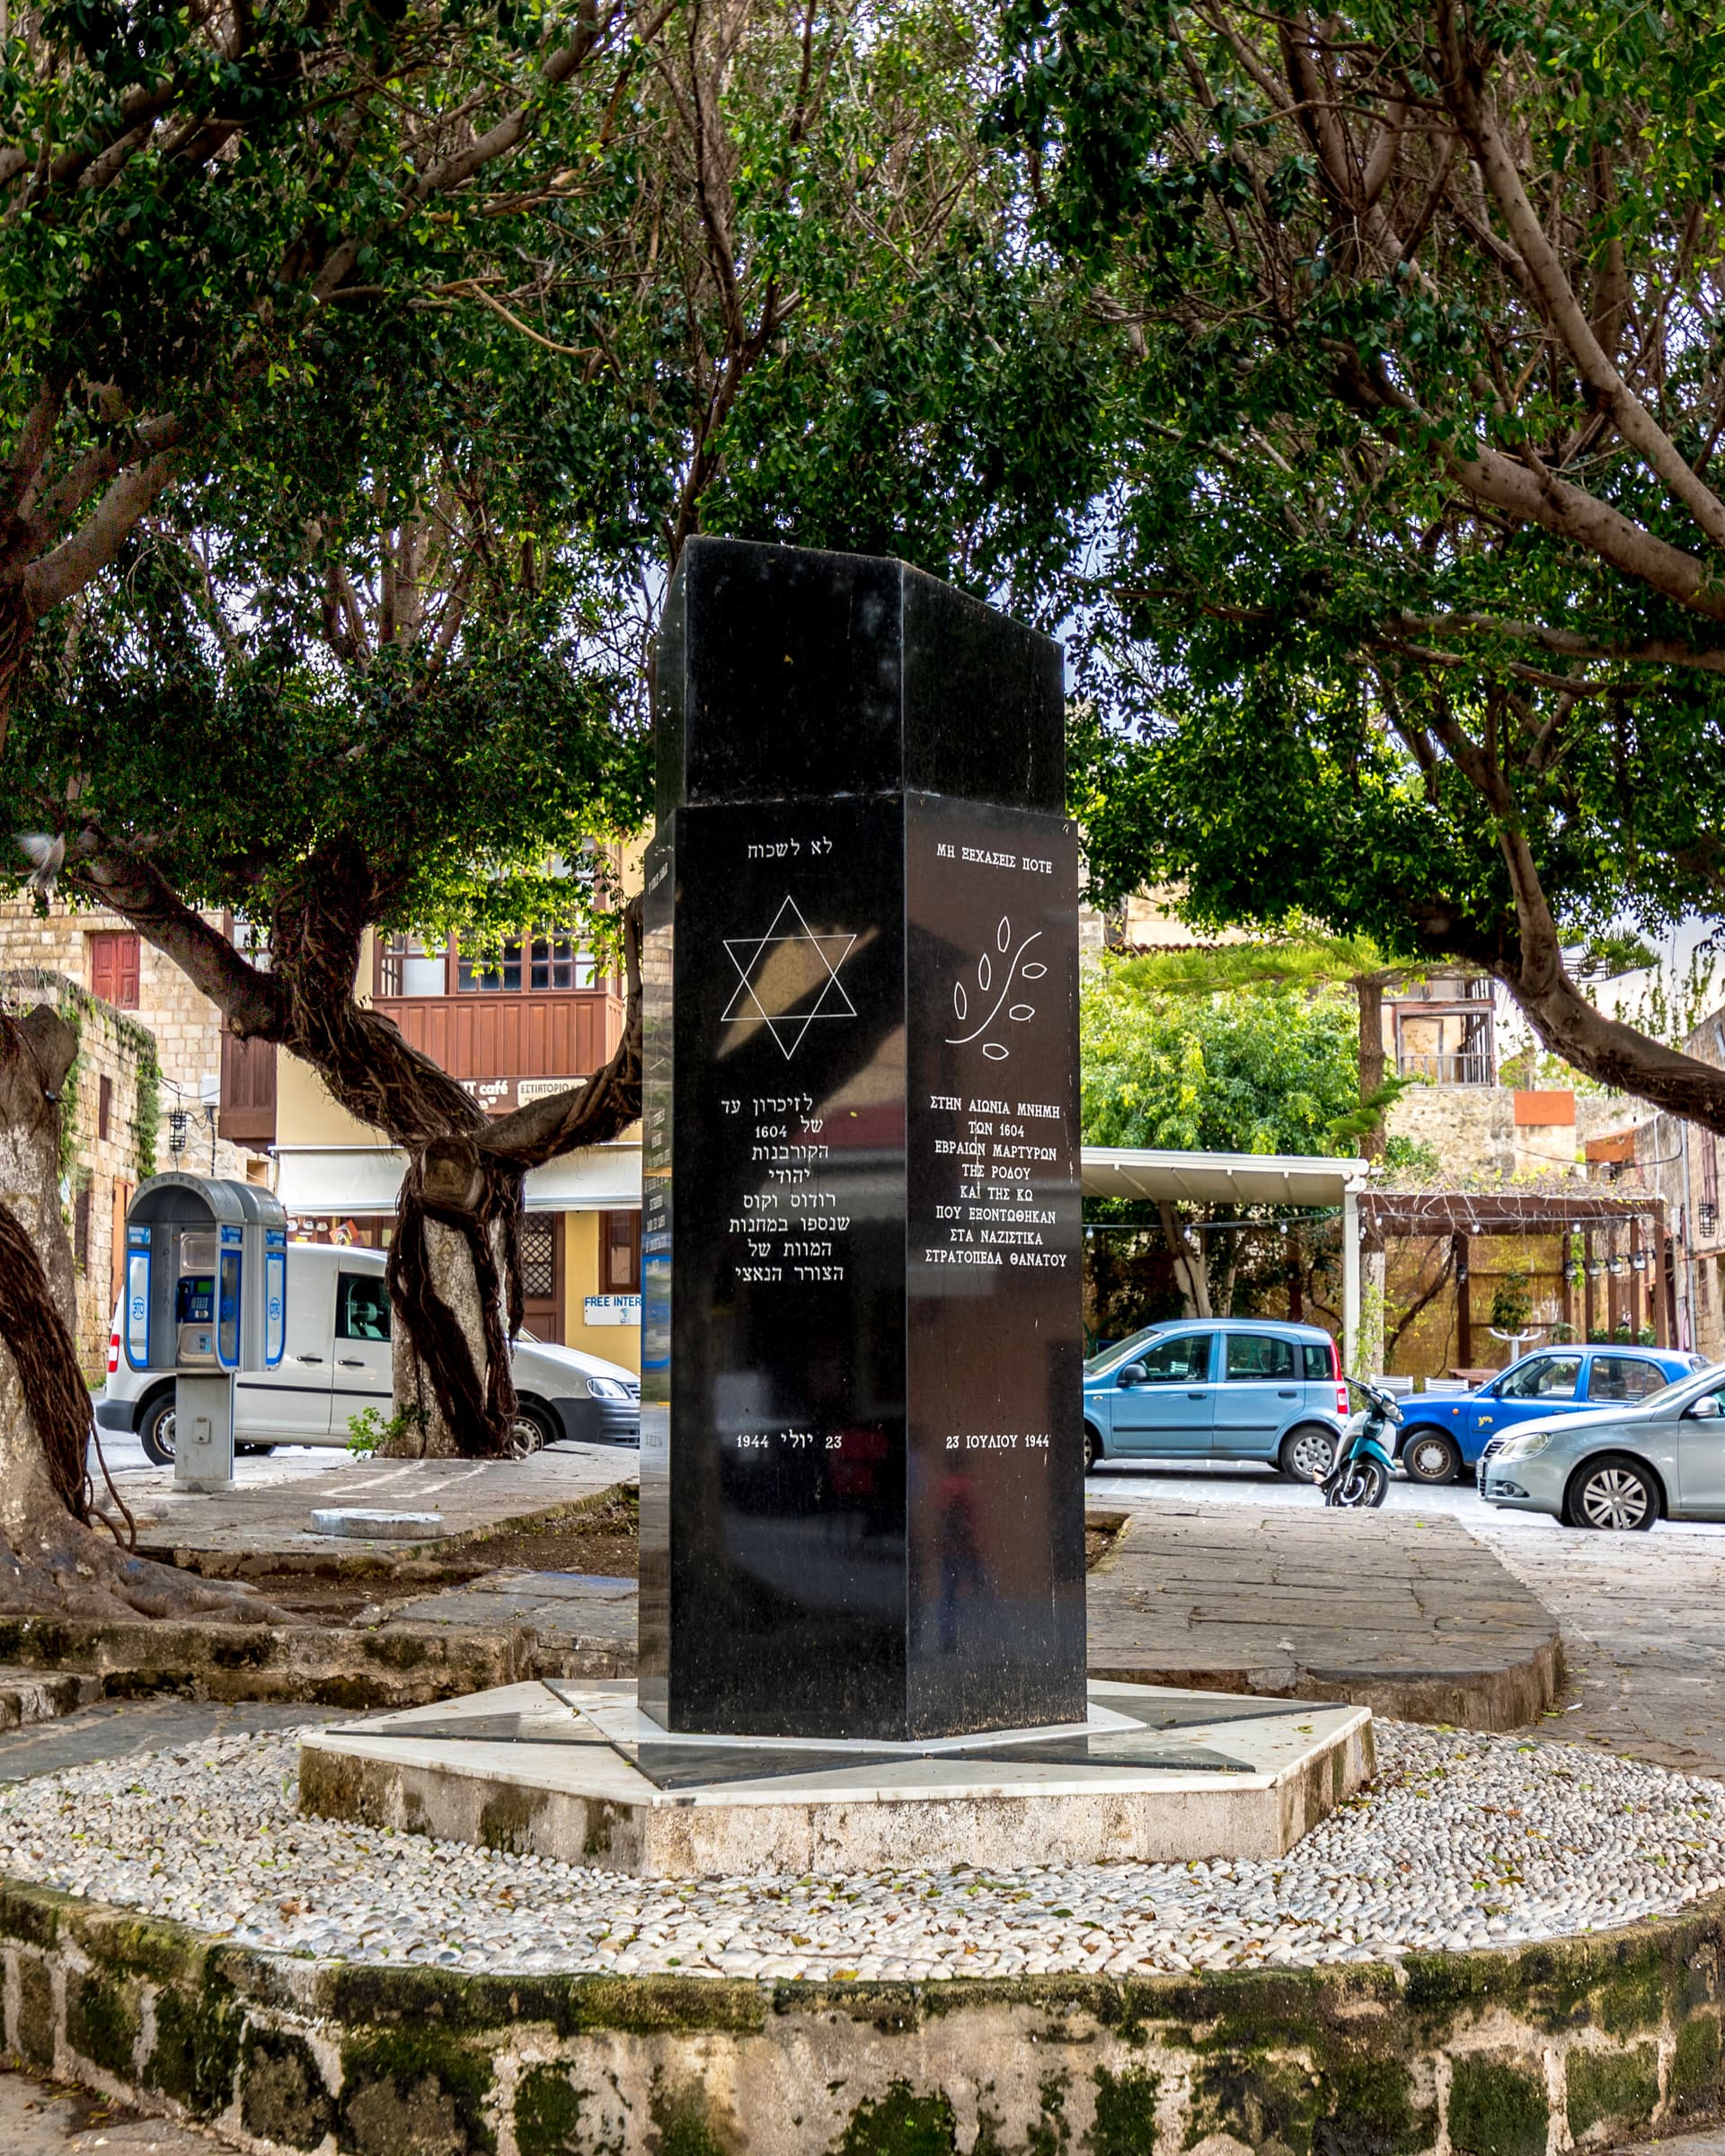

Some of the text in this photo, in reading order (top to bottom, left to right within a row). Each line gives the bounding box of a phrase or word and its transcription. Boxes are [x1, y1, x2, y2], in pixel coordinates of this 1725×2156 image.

[748, 835, 834, 859] לא לשכוח
[936, 843, 1053, 874] ΜΗ ΞΕΧΑΣΕΙΣ ΠΟΤΕ
[479, 1080, 509, 1096] café
[721, 1092, 813, 1117] לזיכרון עד
[930, 1095, 1061, 1119] ΣΤΗΝ ΑΙΩΝΙΑ ΜΝΗΜΗ
[754, 1114, 824, 1139] של 1604
[968, 1120, 1025, 1138] ΤΩΝ 1604
[751, 1144, 829, 1162] הקורבנות
[934, 1139, 1057, 1162] ΕΒΡΑΙΩΝ ΜΑΡΤΥΡΩΝ
[768, 1168, 811, 1184] יהודי
[961, 1163, 1031, 1180] ΤΗΣ ΡΟΔΟΥ
[743, 1192, 836, 1212] רודוס וקוס
[960, 1185, 1034, 1202] ΚΑΙ ΤΗΣ ΚΩ
[935, 1205, 1057, 1224] ΠΟΥ ΕΞΟΝΤΩΘΗΚΑΝ
[728, 1215, 851, 1233] שנספו במחנות
[950, 1228, 1043, 1246] ΣΤΑ ΝΑΖΙΣΤΙΚΑ
[748, 1238, 832, 1258] המוות של
[924, 1249, 1067, 1268] ΣΤΡΑΤΟΠΕΔΑ ΘΑΝΑΤΟΥ
[735, 1266, 844, 1282] הצורר הנאצי
[584, 1295, 610, 1307] FREE
[736, 1428, 843, 1449] 23 יולי 1944
[945, 1434, 1050, 1449] 23 ΙΟΥΛΙΟΥ 1944
